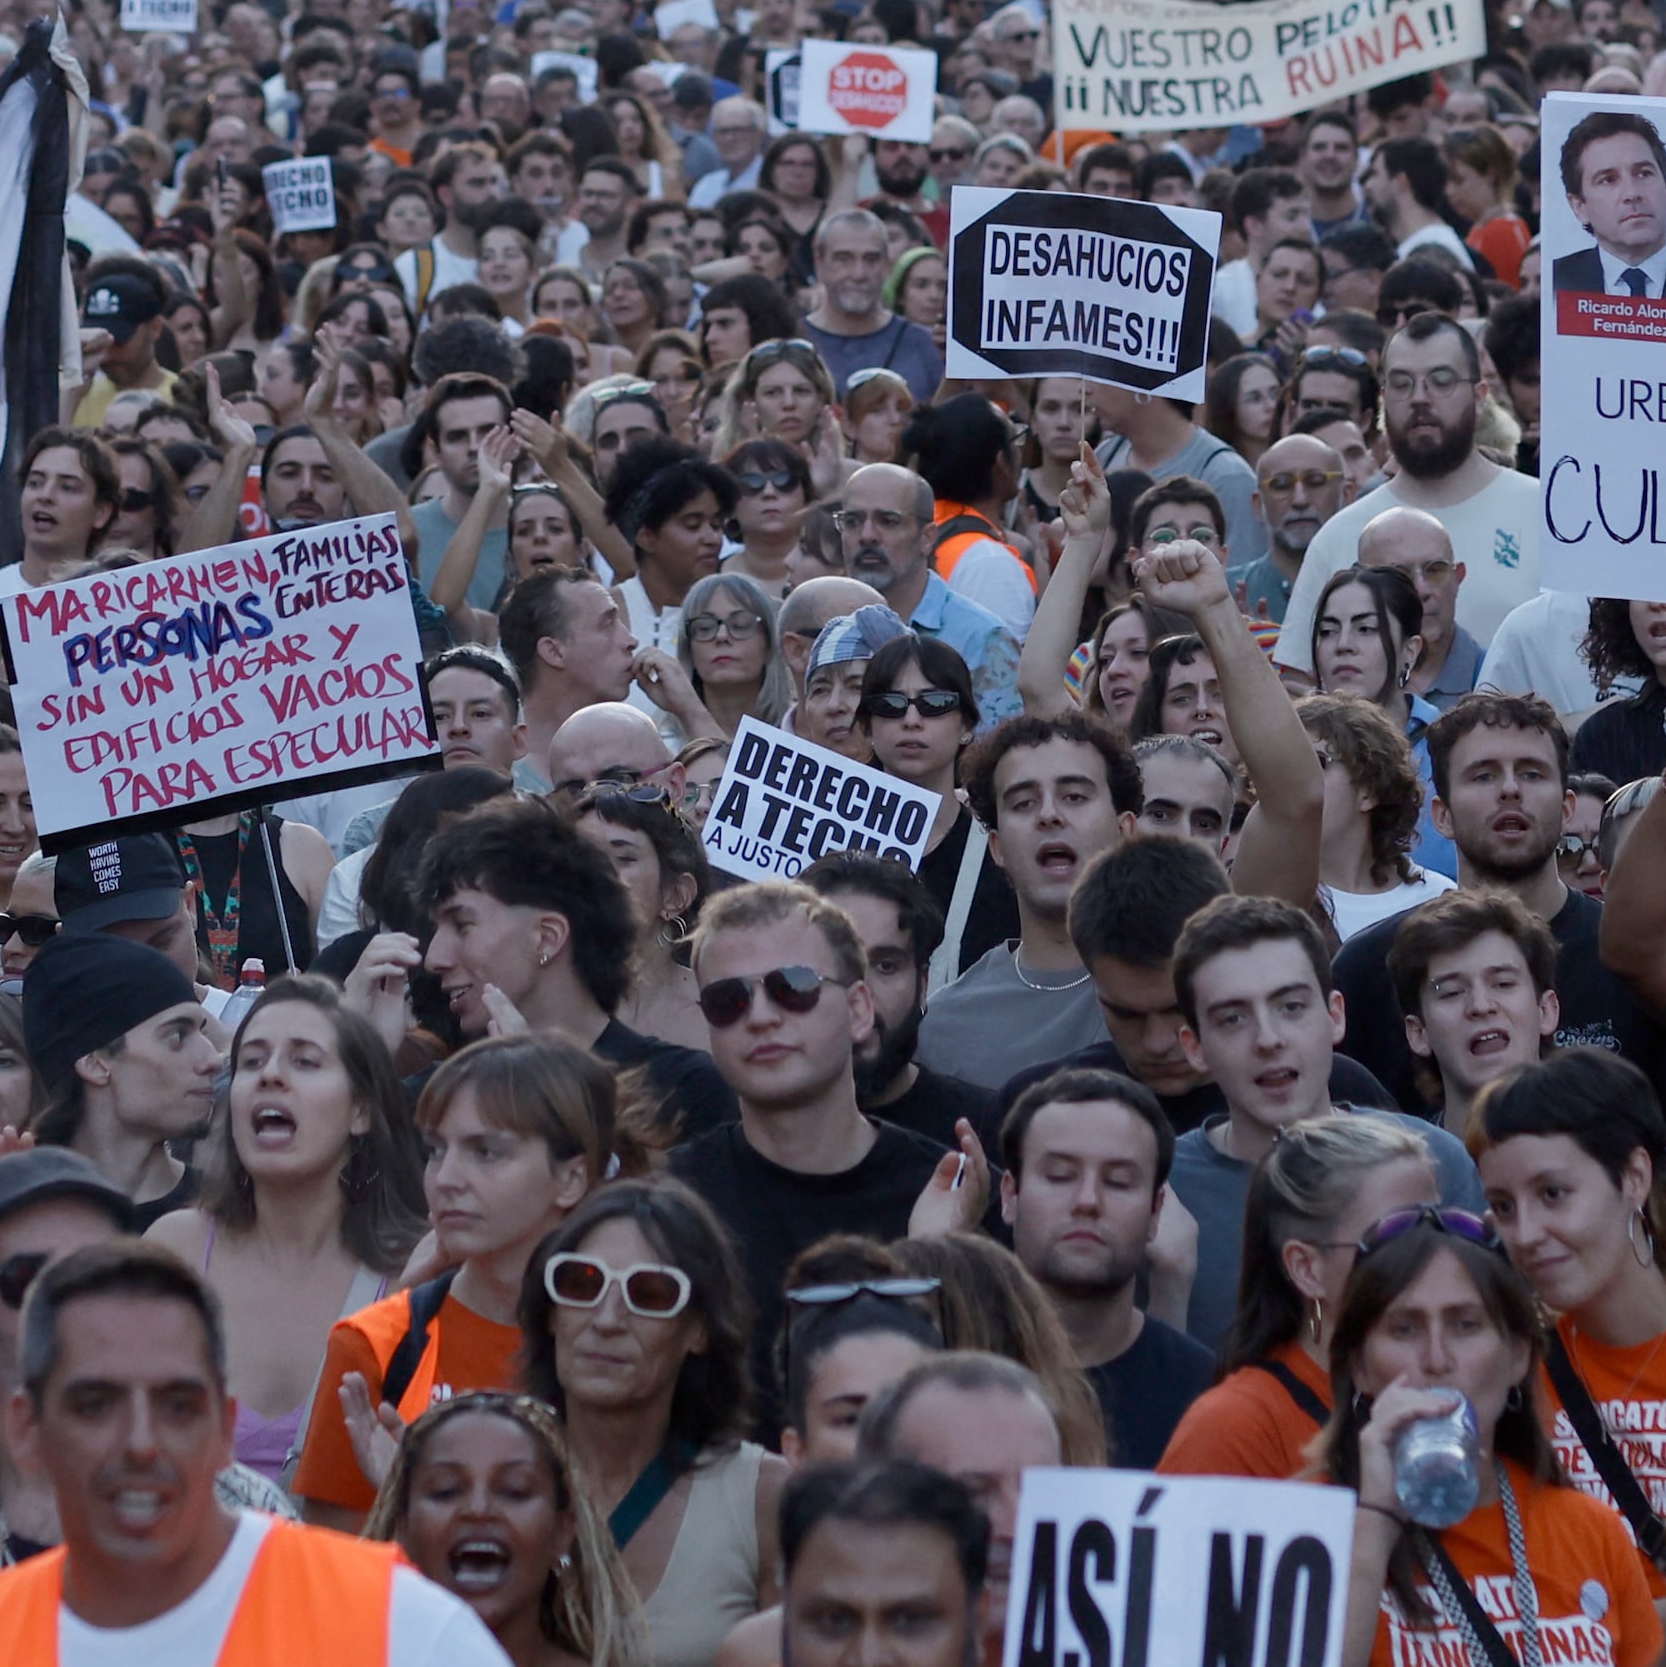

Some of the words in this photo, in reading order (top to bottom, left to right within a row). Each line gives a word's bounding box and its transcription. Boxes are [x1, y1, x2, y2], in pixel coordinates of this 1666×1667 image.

[1069, 22, 1253, 69] VUESTRO
[832, 66, 906, 93] STOP
[990, 230, 1187, 297] DESAHUCIOS
[985, 299, 1179, 364] INFAMES!!!
[1577, 299, 1634, 318] Ricardo
[273, 523, 399, 576] FAMILIAS
[62, 591, 274, 687] PERSONAS
[36, 684, 106, 731] SIN
[120, 665, 174, 707] UN
[190, 633, 316, 707] HOGAR
[328, 623, 360, 660] Y
[99, 757, 217, 818] PARA
[223, 706, 439, 785] ESPECULAR
[715, 780, 750, 830] A
[733, 732, 929, 846] DERECHO
[88, 841, 118, 859] WORTH
[90, 853, 121, 872] HAVING
[93, 865, 123, 883] COMES
[706, 826, 723, 850] A
[728, 835, 803, 880] JUSTO
[98, 878, 120, 894] EASY
[1019, 1487, 1164, 1667] ASÍ
[1202, 1530, 1333, 1667] NO
